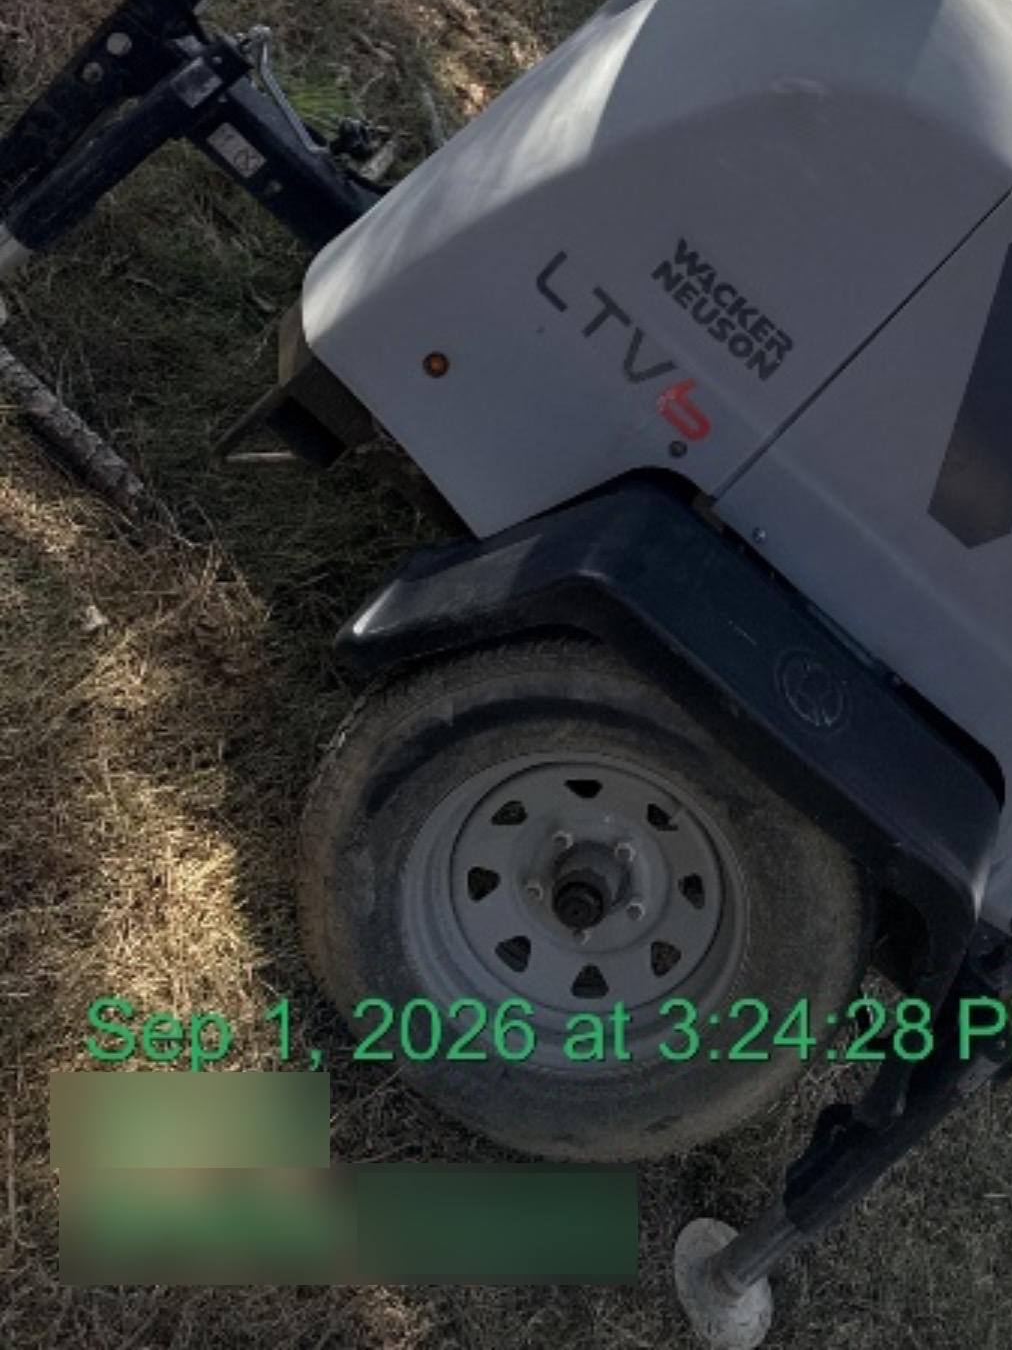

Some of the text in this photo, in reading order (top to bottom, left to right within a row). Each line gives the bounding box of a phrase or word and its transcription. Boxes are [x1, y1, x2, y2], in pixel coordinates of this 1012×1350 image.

[535, 250, 712, 442] LTV6
[651, 260, 784, 382] NEUSON
[674, 237, 794, 363] WACKER
